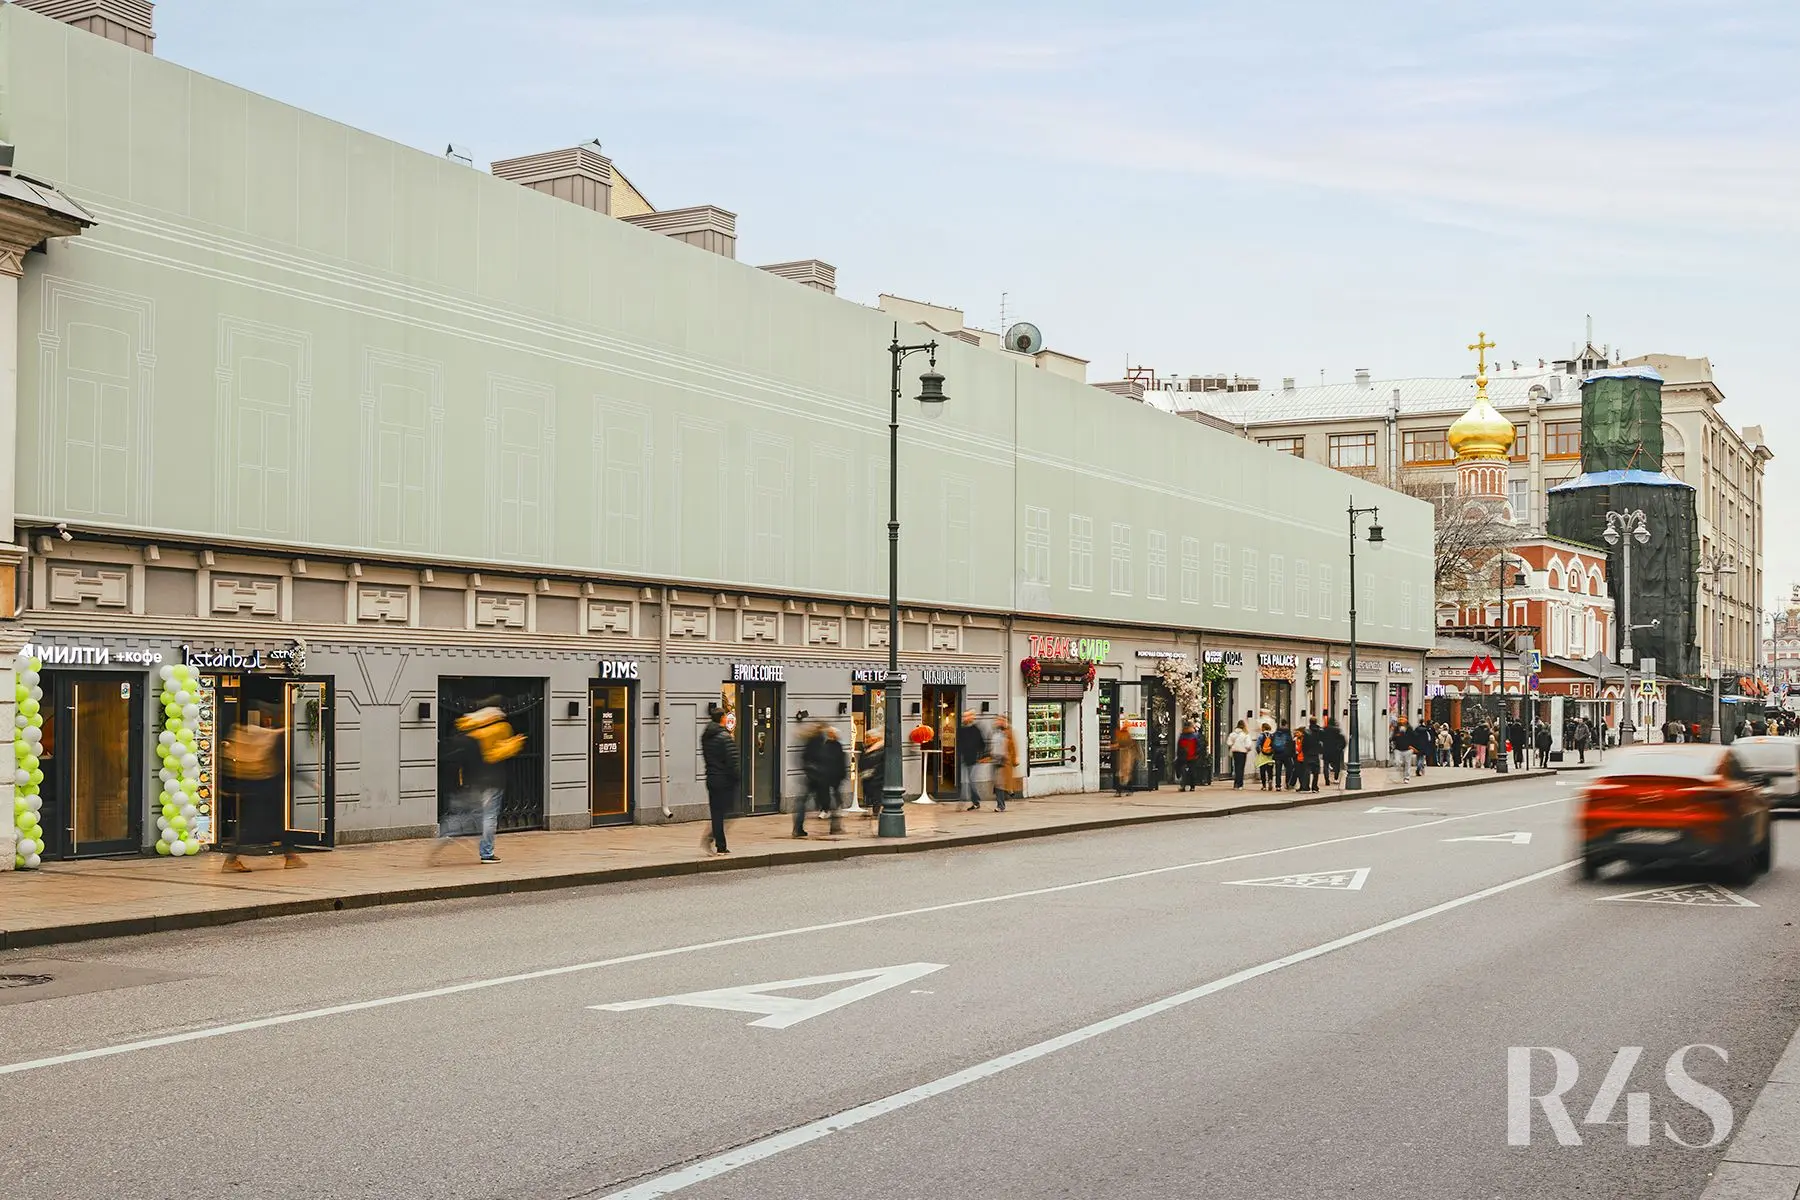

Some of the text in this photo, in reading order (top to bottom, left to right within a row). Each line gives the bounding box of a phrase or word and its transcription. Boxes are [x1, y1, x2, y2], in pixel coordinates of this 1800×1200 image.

[37, 646, 109, 665] МИЛТИ
[1030, 635, 1071, 659] ТАБАК
[1071, 642, 1079, 657] &
[1079, 639, 1111, 665] СИДР
[1260, 654, 1271, 666] TEA
[602, 661, 638, 679] PIMS
[740, 664, 784, 681] PRICE COFFEE
[923, 670, 967, 685] ЧЕБУРЕЧНАЯ
